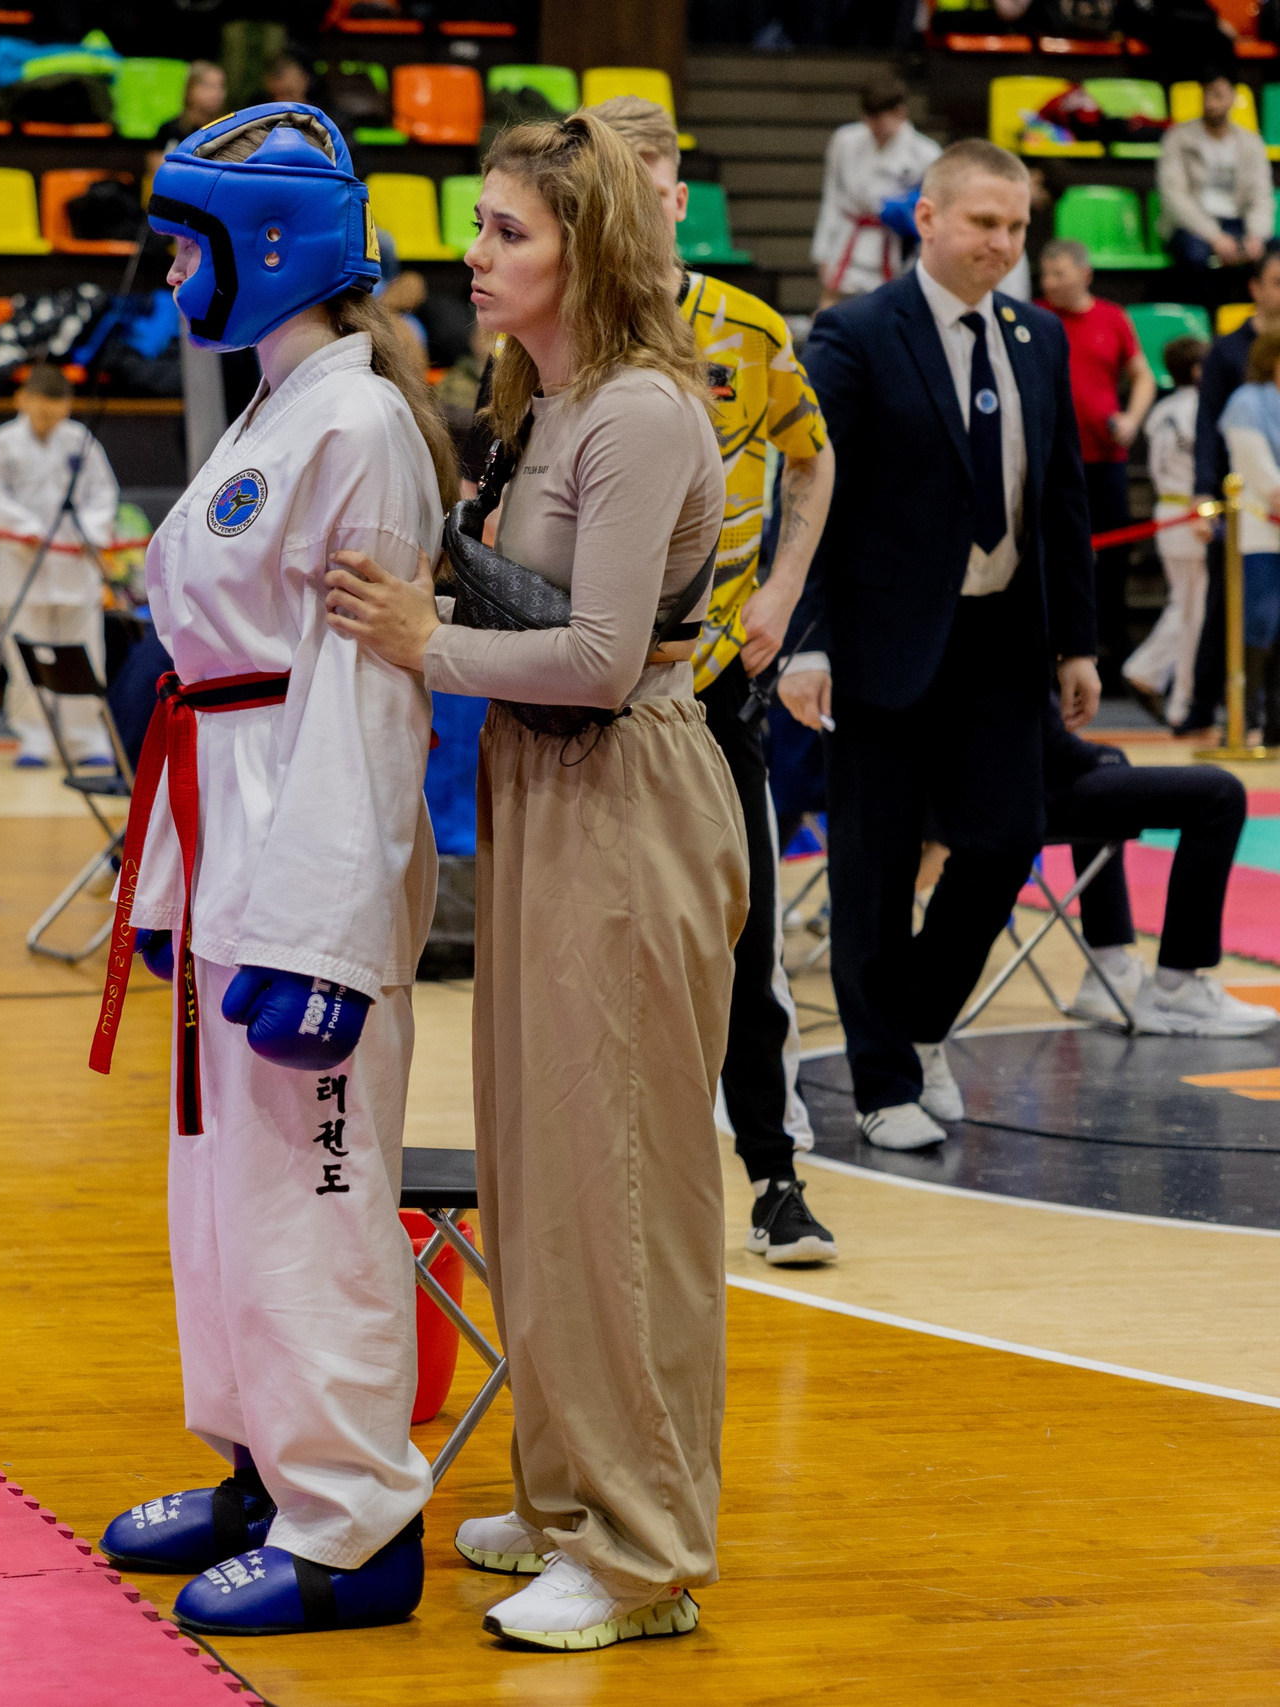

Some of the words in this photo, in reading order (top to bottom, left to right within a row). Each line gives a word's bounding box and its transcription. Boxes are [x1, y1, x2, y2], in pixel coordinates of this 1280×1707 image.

[218, 518, 252, 533] FEDERATION
[298, 993, 327, 1036] TOP
[328, 1003, 341, 1029] Point
[313, 1074, 350, 1195] 태권도
